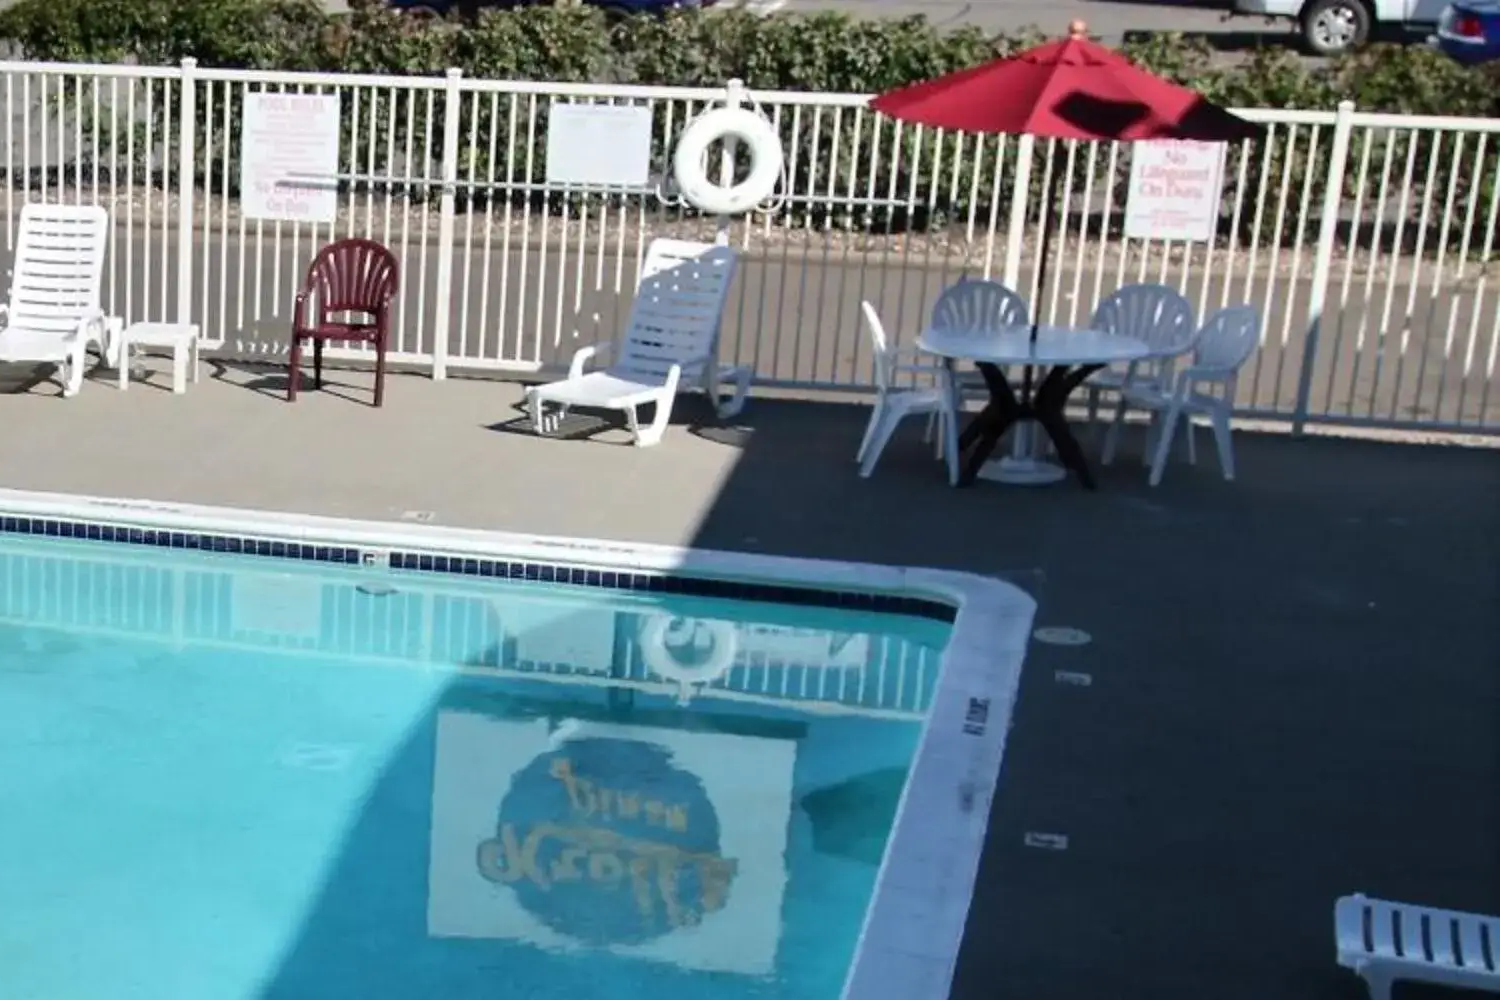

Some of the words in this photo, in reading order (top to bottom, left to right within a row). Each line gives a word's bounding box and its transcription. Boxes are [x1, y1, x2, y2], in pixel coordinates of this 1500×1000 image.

[1164, 150, 1188, 165] No
[1139, 163, 1209, 184] Lifeguard
[1139, 182, 1163, 197] On
